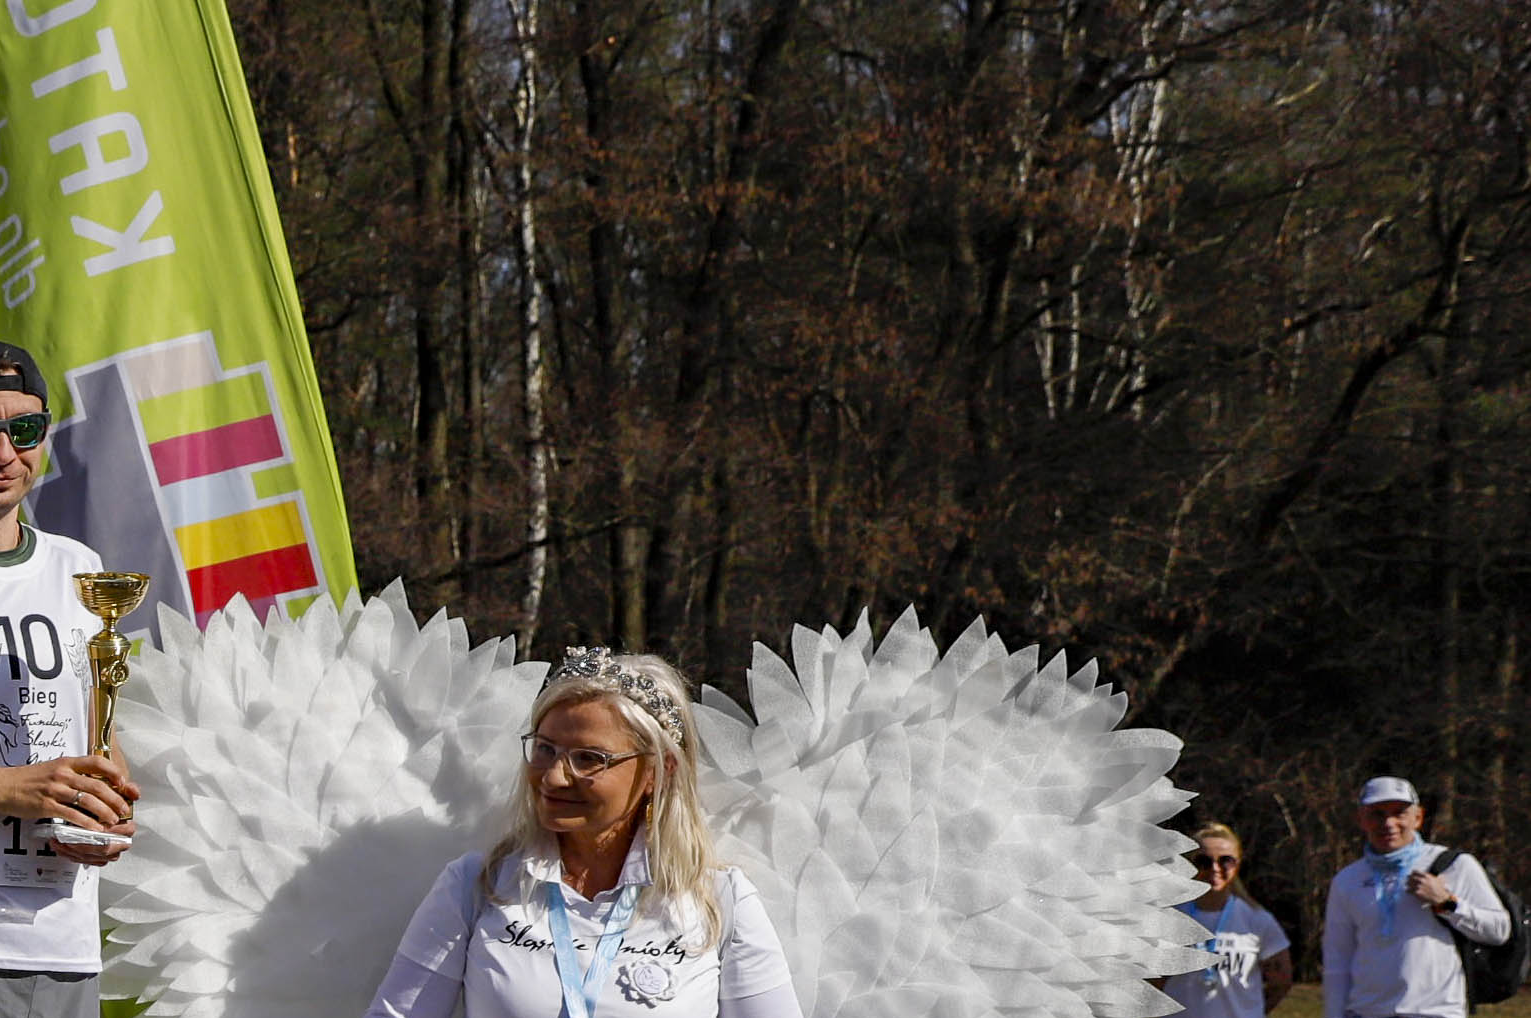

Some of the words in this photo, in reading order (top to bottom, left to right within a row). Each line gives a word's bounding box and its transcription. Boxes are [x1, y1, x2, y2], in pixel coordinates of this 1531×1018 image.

[18, 687, 57, 709] Bieg
[498, 920, 589, 953] Śląse
[618, 934, 686, 965] nioły
